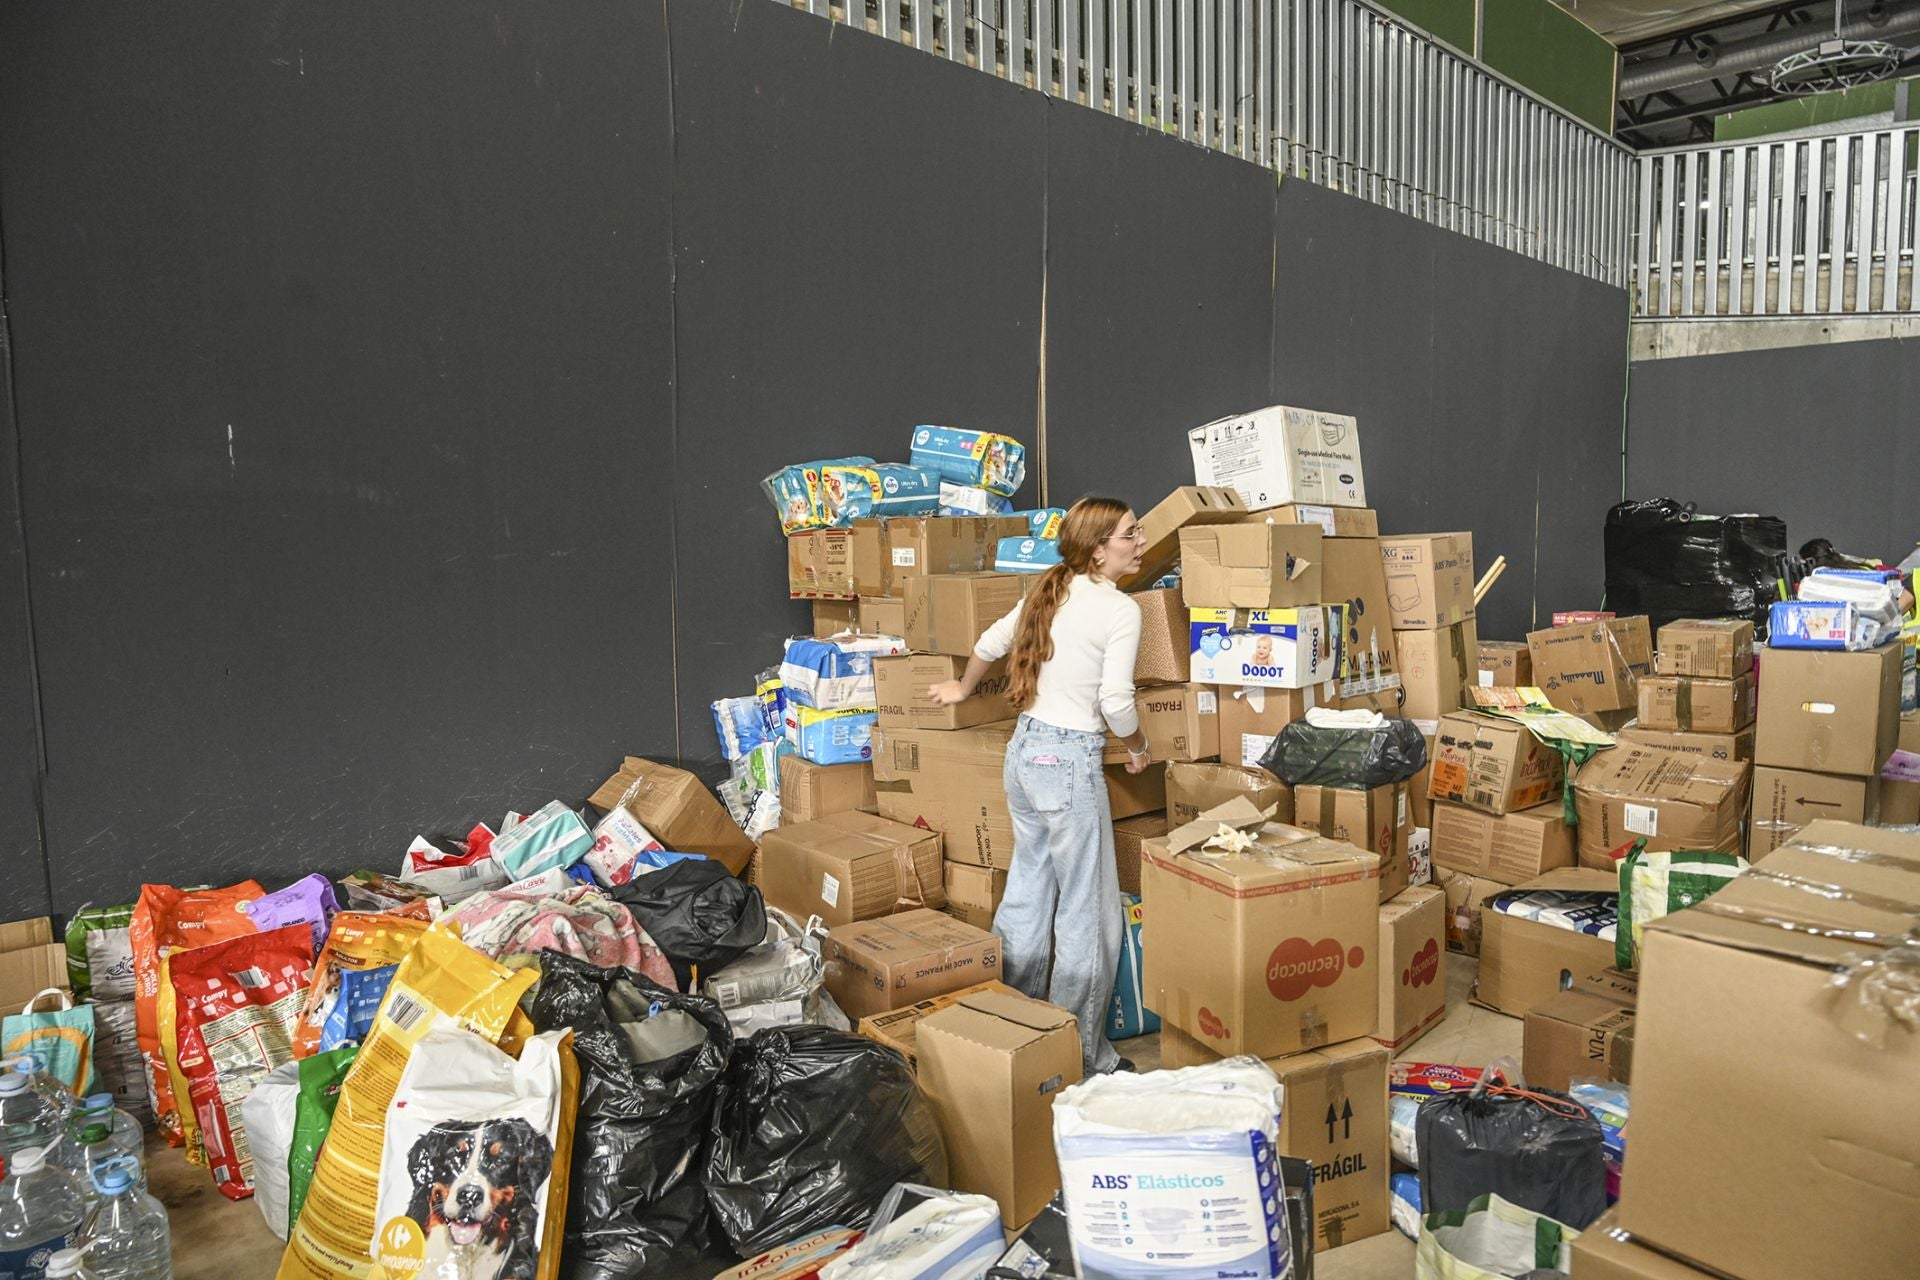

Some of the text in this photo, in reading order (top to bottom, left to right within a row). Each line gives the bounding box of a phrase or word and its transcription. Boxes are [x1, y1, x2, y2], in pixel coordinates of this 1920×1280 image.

[1383, 548, 1398, 558] XG
[1252, 611, 1268, 622] XL
[1311, 627, 1319, 676] DODOT
[1242, 663, 1284, 678] DODOT
[1560, 670, 1605, 686] Massilly
[880, 705, 905, 716] FRAGIL
[346, 928, 364, 938] Compy
[335, 952, 358, 964] ADULTOS
[1412, 952, 1438, 978] tecnocap
[916, 966, 944, 979] FRANCE
[1268, 954, 1340, 981] tecnocap
[202, 988, 228, 1004] Compy
[1312, 1152, 1367, 1186] FRÁGIL
[1137, 1174, 1224, 1190] Elásticos
[738, 1232, 835, 1278] IncoPack
